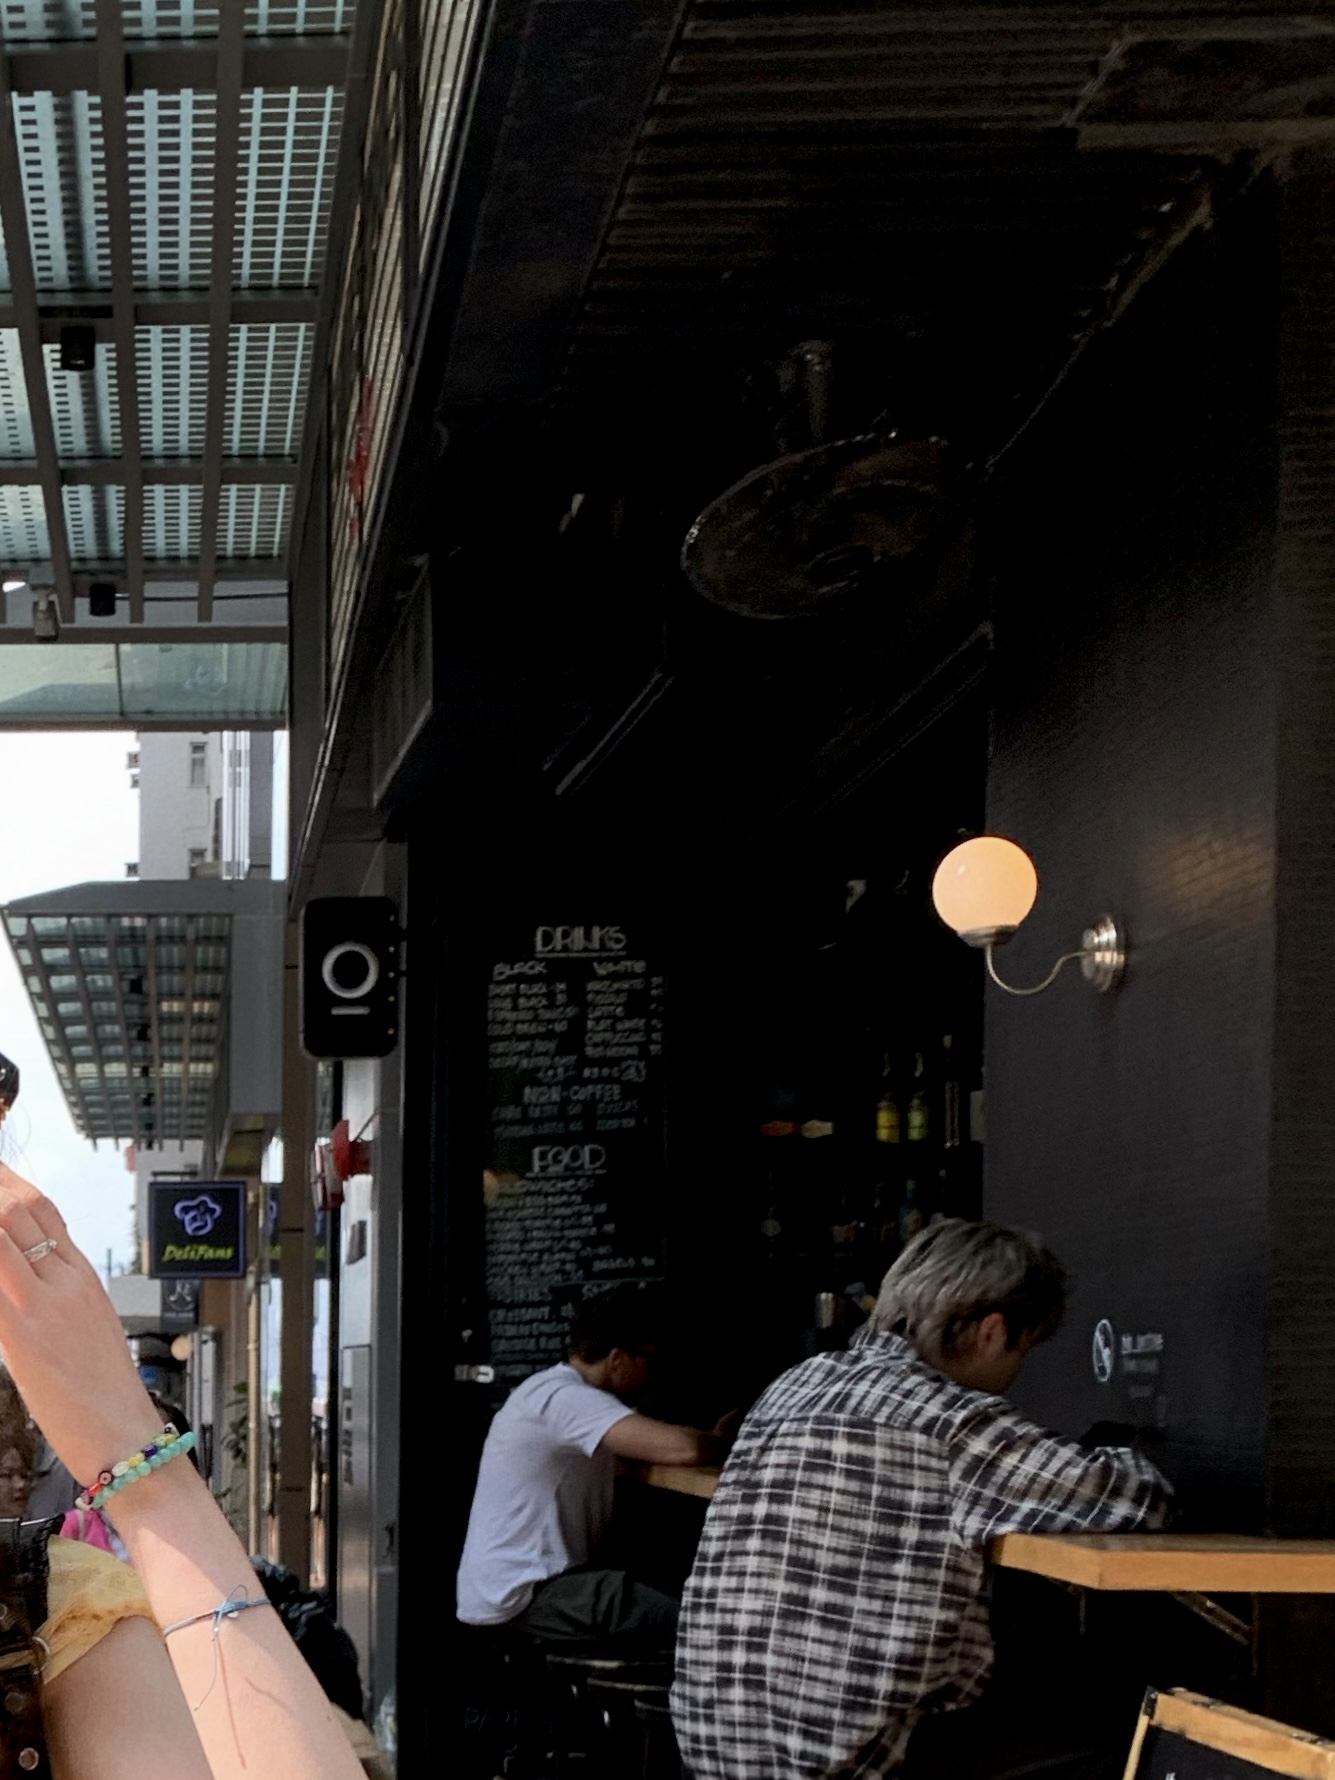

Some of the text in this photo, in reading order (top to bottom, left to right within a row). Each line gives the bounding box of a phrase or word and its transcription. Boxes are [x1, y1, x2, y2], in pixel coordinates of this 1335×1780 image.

[534, 924, 627, 952] DRINKS
[492, 960, 549, 982] BLACK
[593, 960, 647, 977] WHITE
[530, 1142, 607, 1173] FOOD
[161, 1244, 234, 1263] DeliFans
